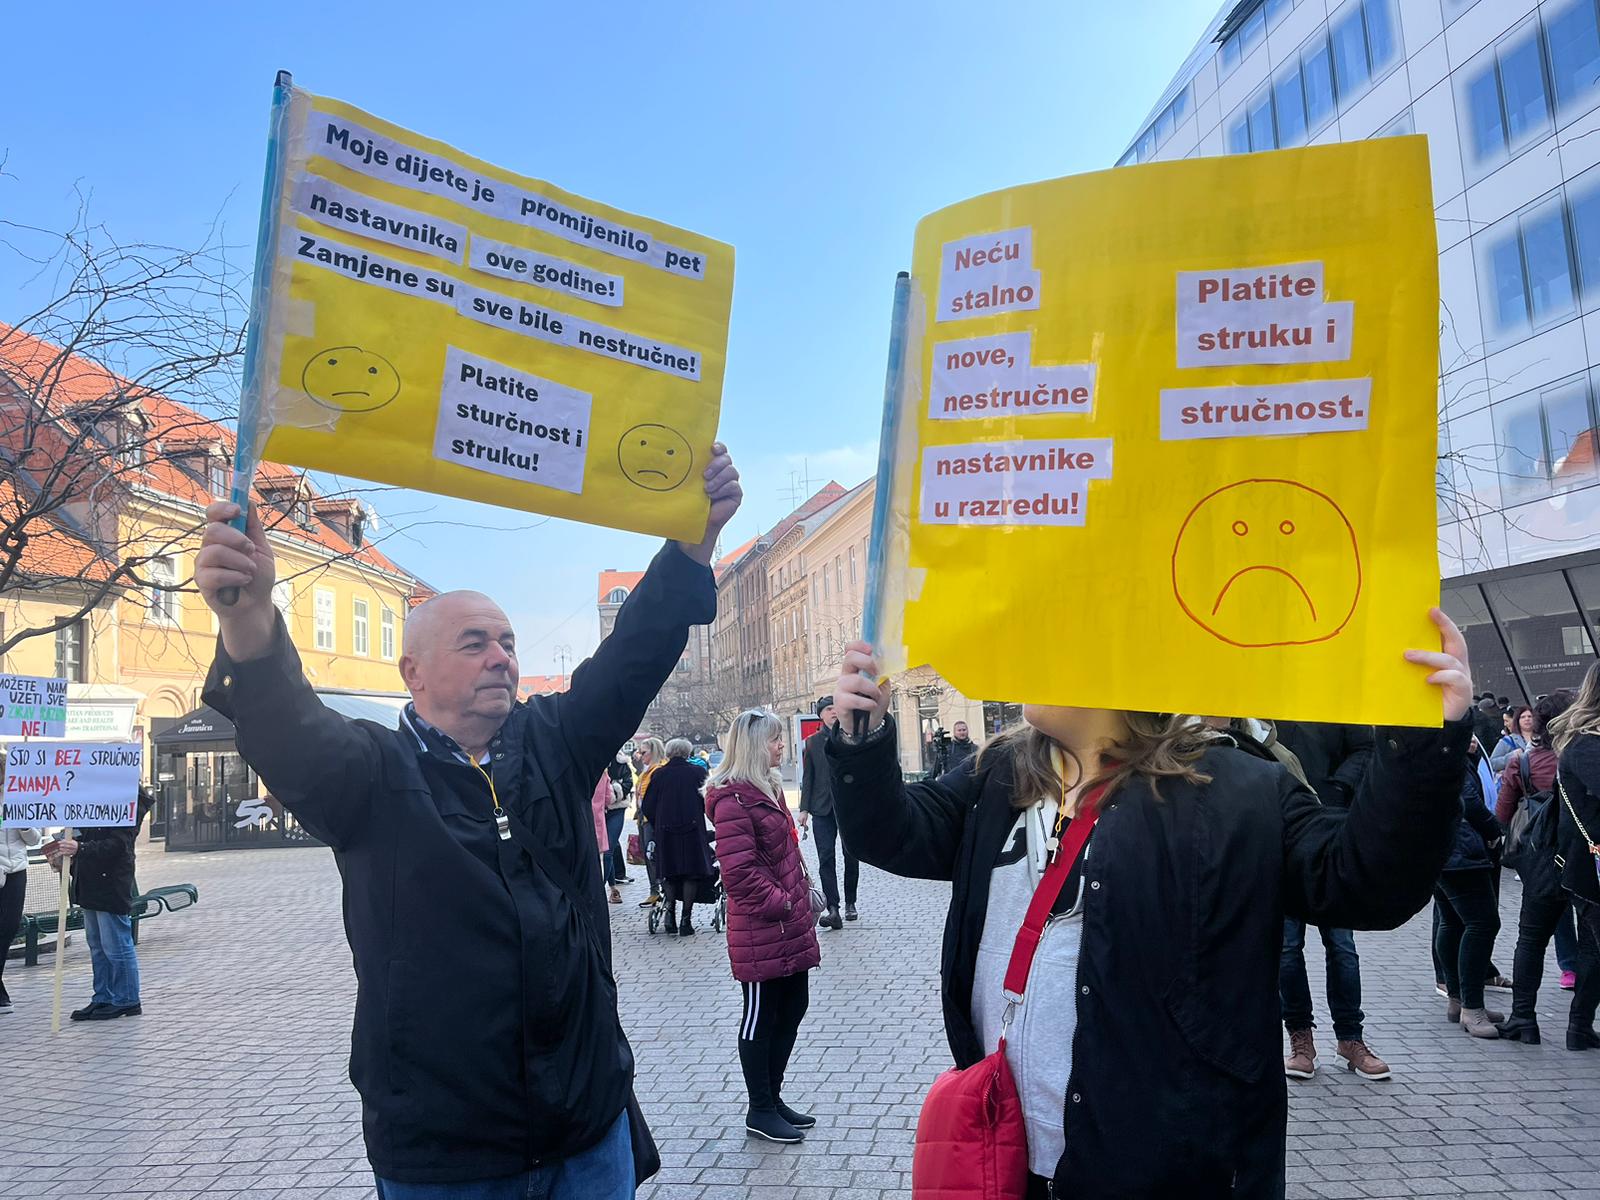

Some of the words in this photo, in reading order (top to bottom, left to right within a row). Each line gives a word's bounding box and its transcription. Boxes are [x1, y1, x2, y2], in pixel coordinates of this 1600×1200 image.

[326, 122, 388, 167] Moje
[396, 151, 468, 194] dijete
[472, 175, 495, 203] je
[521, 196, 648, 254] promijenilo
[664, 249, 701, 274] pet
[310, 193, 458, 253] nastavnika
[486, 250, 528, 274] ove
[533, 262, 615, 298] godine!
[955, 241, 1020, 272] Neću
[951, 284, 1034, 313] stalno
[1198, 274, 1316, 303] Platite
[298, 236, 419, 288] Zamjene
[425, 277, 455, 299] su
[473, 297, 513, 321] sve
[519, 307, 563, 336] bile
[579, 326, 697, 374] nestručne!
[1197, 323, 1312, 351] struku
[1326, 319, 1335, 343] i
[947, 348, 1015, 370] nove,
[460, 363, 540, 402] Platite
[943, 384, 1089, 412] nestručne
[1181, 395, 1364, 425] stručnost.
[456, 402, 571, 444] sturčnost
[574, 430, 584, 448] i
[452, 437, 539, 472] struku!
[936, 448, 1095, 476] nastavnike
[934, 502, 950, 518] u
[959, 492, 1079, 517] razredu!
[9, 691, 42, 705] UZETI
[47, 693, 65, 706] SVE
[46, 682, 68, 694] NAM
[10, 746, 30, 766] ŠTO
[36, 749, 46, 765] SI
[55, 749, 82, 766] BEZ
[89, 747, 140, 767] STRUČNOG
[2, 803, 57, 821] MINISTAR
[64, 802, 136, 823] OBRAZOVANJA!
